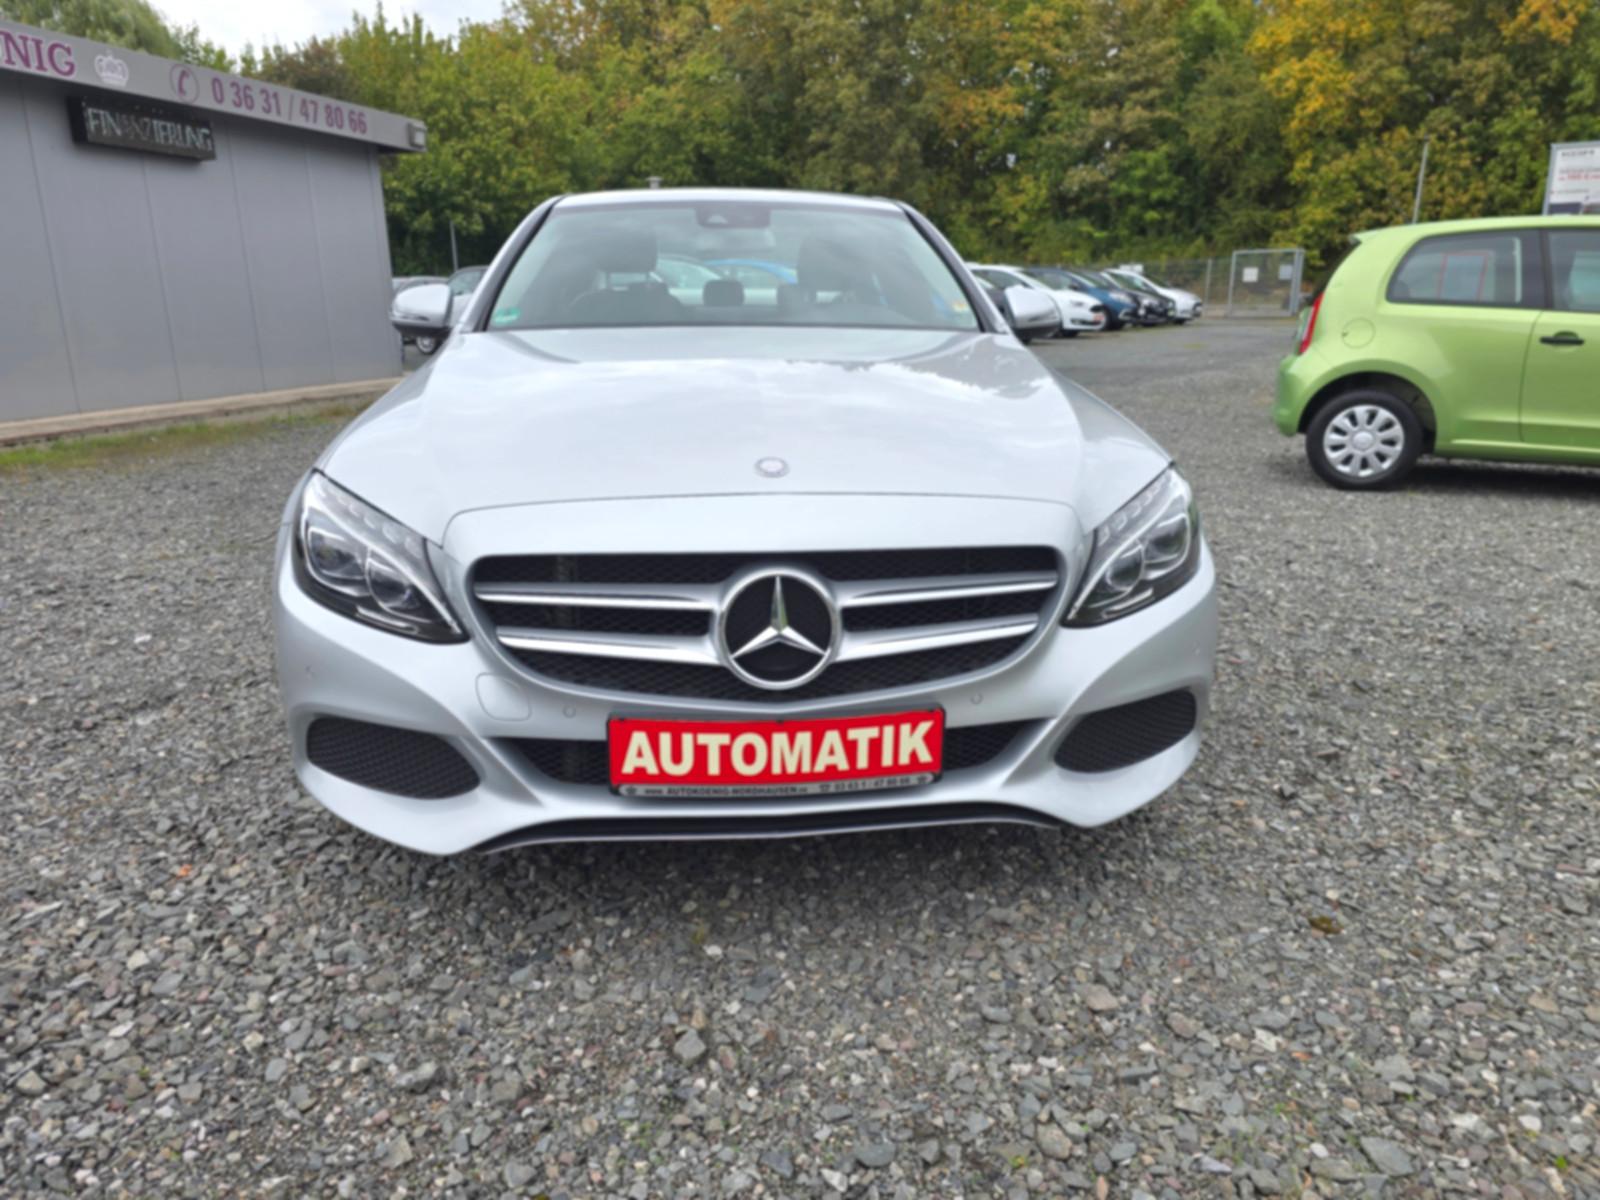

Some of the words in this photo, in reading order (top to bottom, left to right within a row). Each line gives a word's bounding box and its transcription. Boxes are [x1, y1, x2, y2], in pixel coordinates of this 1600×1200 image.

[0, 29, 76, 77] NIG
[211, 77, 224, 104] 0
[230, 81, 255, 111] 36
[259, 88, 282, 117] 31
[300, 98, 319, 124] 47
[324, 104, 345, 130] 80
[348, 110, 368, 135] 66
[621, 720, 934, 777] AUTOMATIK
